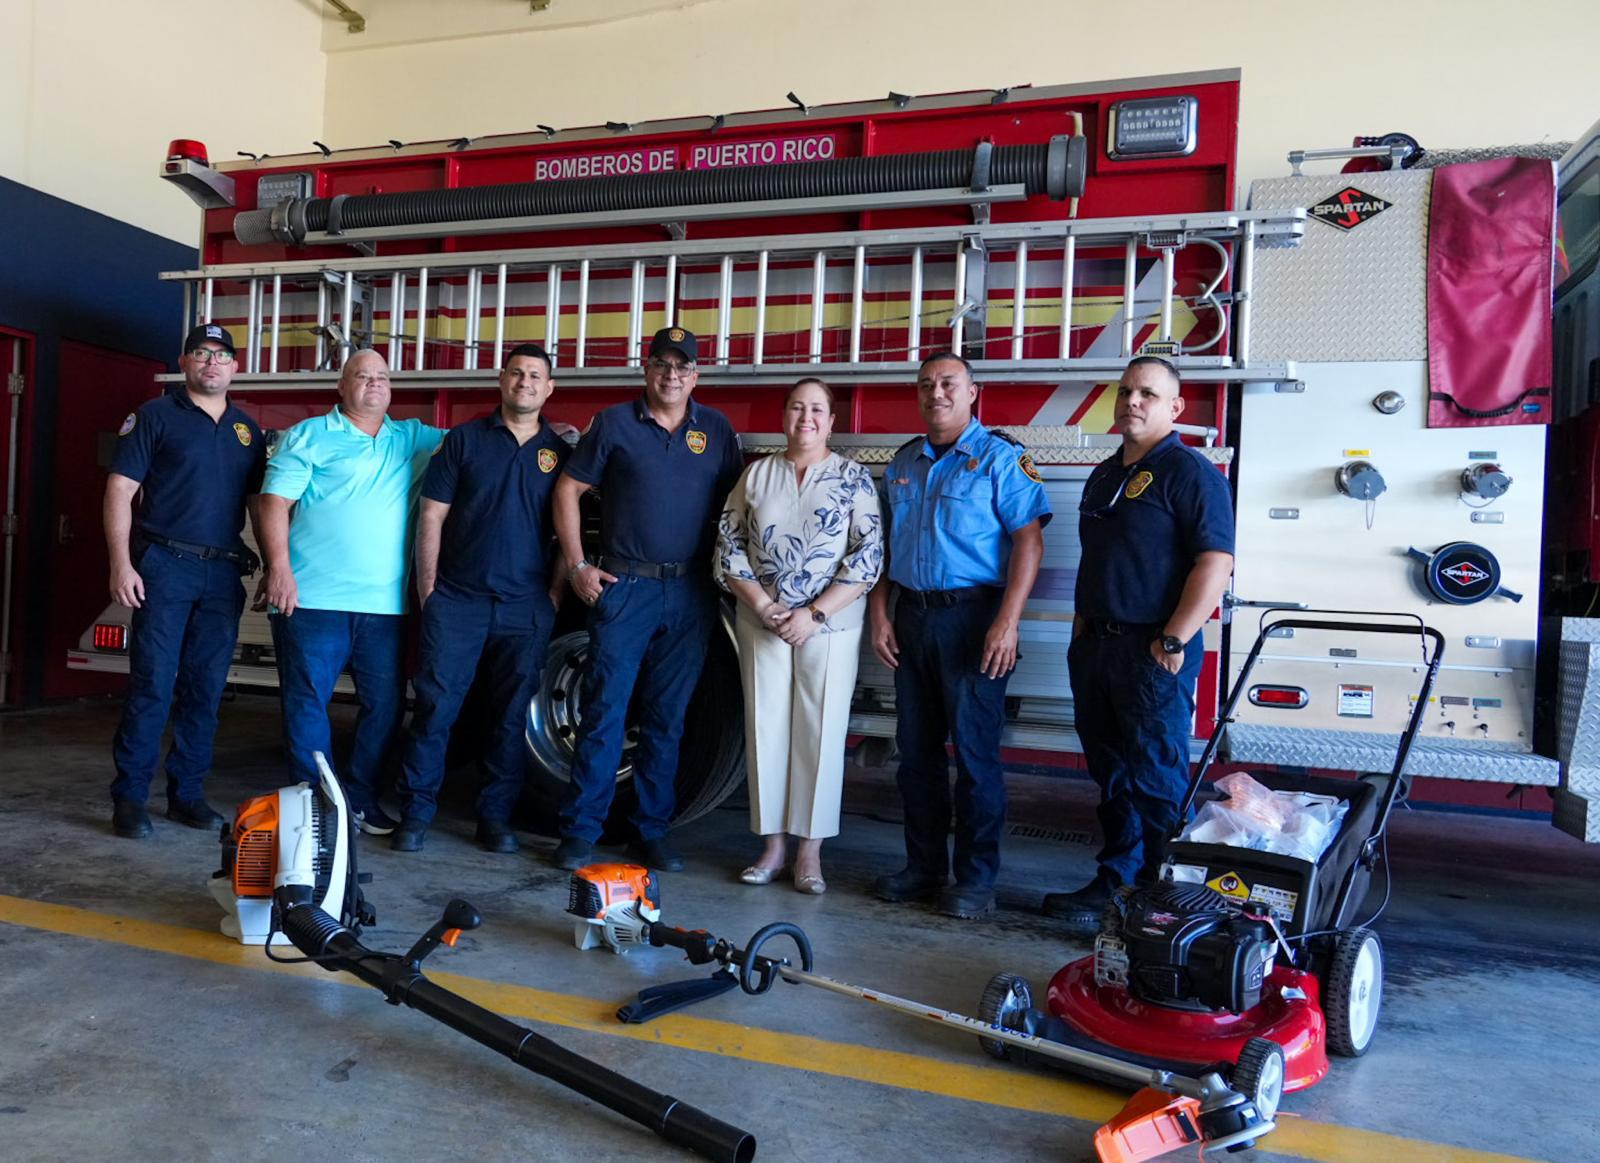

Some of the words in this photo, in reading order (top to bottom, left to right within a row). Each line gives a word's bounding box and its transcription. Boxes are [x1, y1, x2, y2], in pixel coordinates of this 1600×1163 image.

[536, 154, 642, 180] BOMBEROS
[649, 150, 675, 172] DE
[694, 141, 776, 168] PUERTO
[782, 137, 835, 161] RICO
[1314, 201, 1384, 215] SPARTAN
[1446, 569, 1484, 578] SPARTAN
